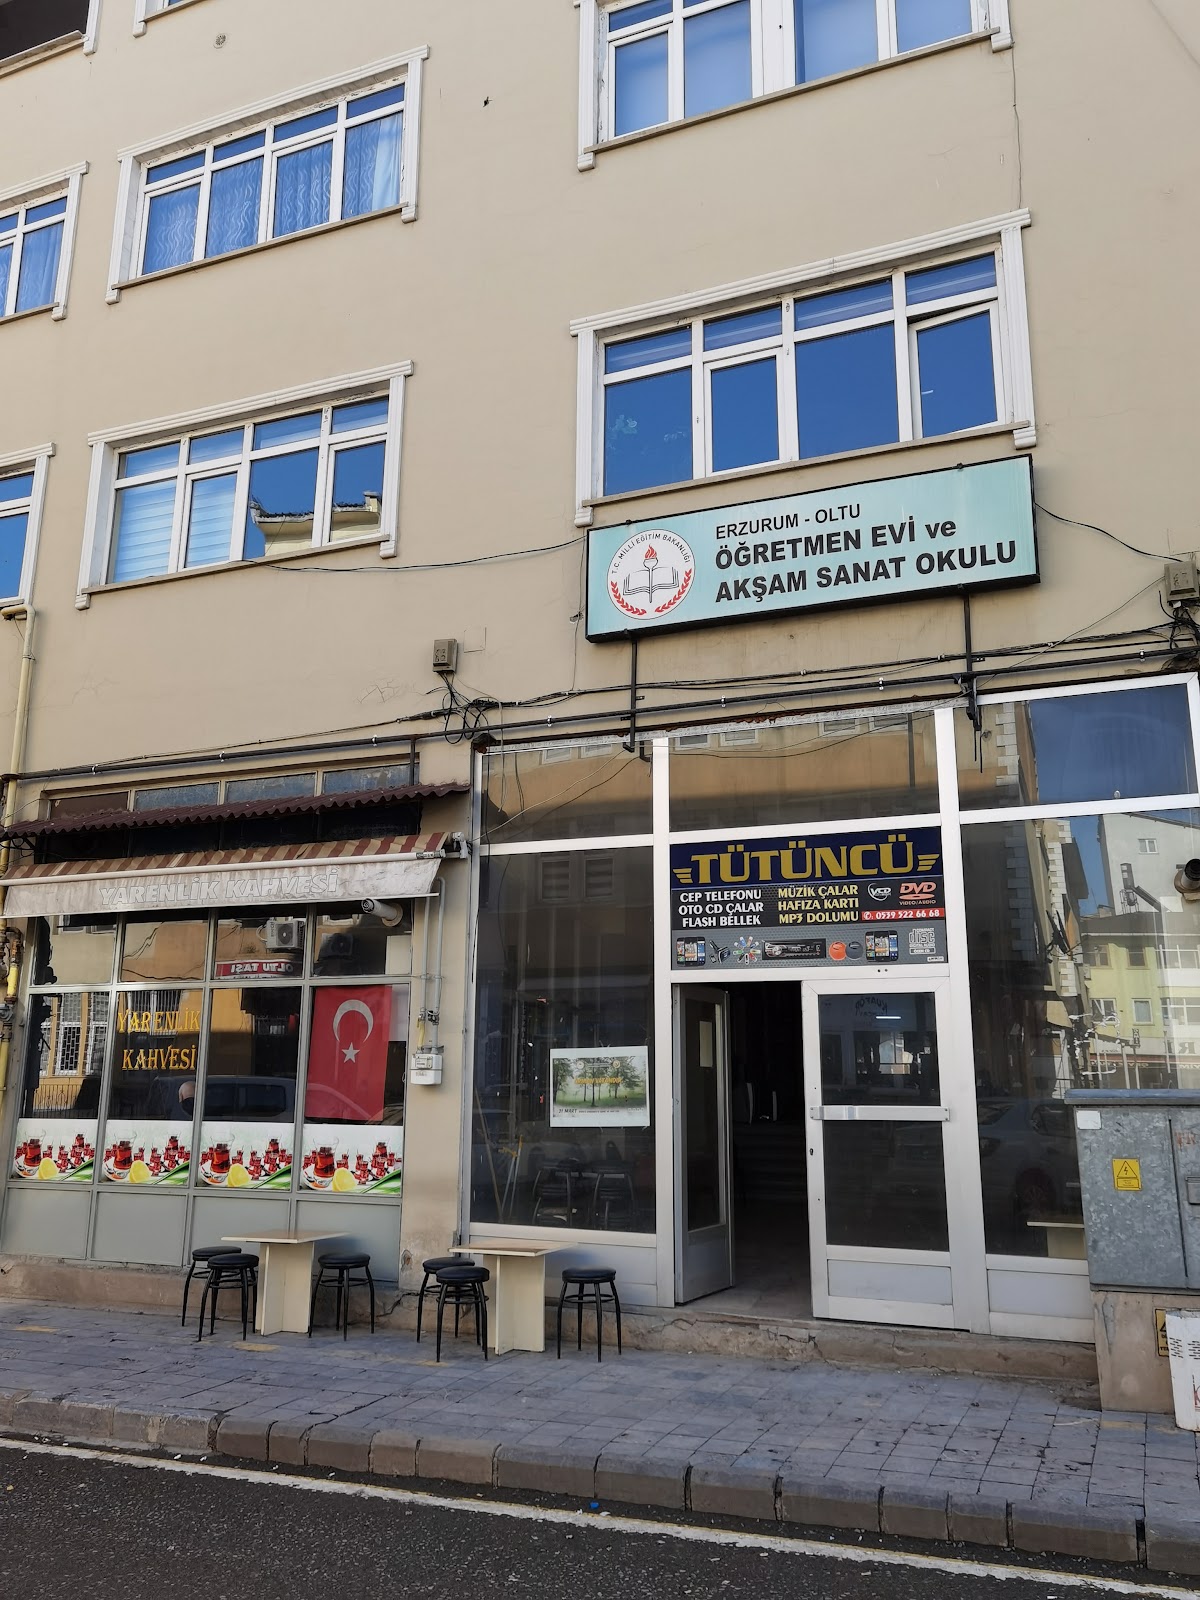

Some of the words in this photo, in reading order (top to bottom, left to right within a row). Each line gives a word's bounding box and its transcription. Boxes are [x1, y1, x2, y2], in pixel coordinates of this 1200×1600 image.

[715, 514, 799, 540] ERZURUM
[815, 503, 862, 525] OLTU
[618, 541, 636, 560] MİLLİ
[636, 532, 661, 545] EĞİTİM
[662, 534, 691, 563] BAKANLIĞI
[715, 532, 862, 570] ÖĞRETMEN
[872, 515, 916, 547] EVİ
[925, 519, 957, 540] ve
[715, 572, 807, 603] AKŞAM
[816, 556, 906, 589] SANAT
[915, 540, 1017, 575] OKULU
[690, 833, 914, 884] TÜTÜNCÜ
[100, 877, 220, 905] YARENLİK
[225, 868, 339, 899] KAHVESİ
[679, 891, 702, 903] CEP
[704, 889, 762, 902] TELEFONU
[778, 884, 816, 899] MÜZİK
[818, 884, 859, 898] ÇALAR
[900, 882, 937, 894] DVD
[678, 904, 704, 916] OTO
[706, 903, 723, 915] CD
[725, 901, 764, 916] ÇALAR
[778, 899, 822, 912] HAFIZA
[824, 897, 859, 910] KARTI
[916, 910, 926, 918] 66
[929, 909, 940, 917] 68
[682, 916, 717, 928] FLASH
[719, 914, 761, 926] BELLEK
[778, 912, 803, 924] MP3
[806, 911, 859, 923] DOLUMU
[118, 1008, 200, 1033] YARENLİK
[122, 1044, 196, 1071] KAHVESİ
